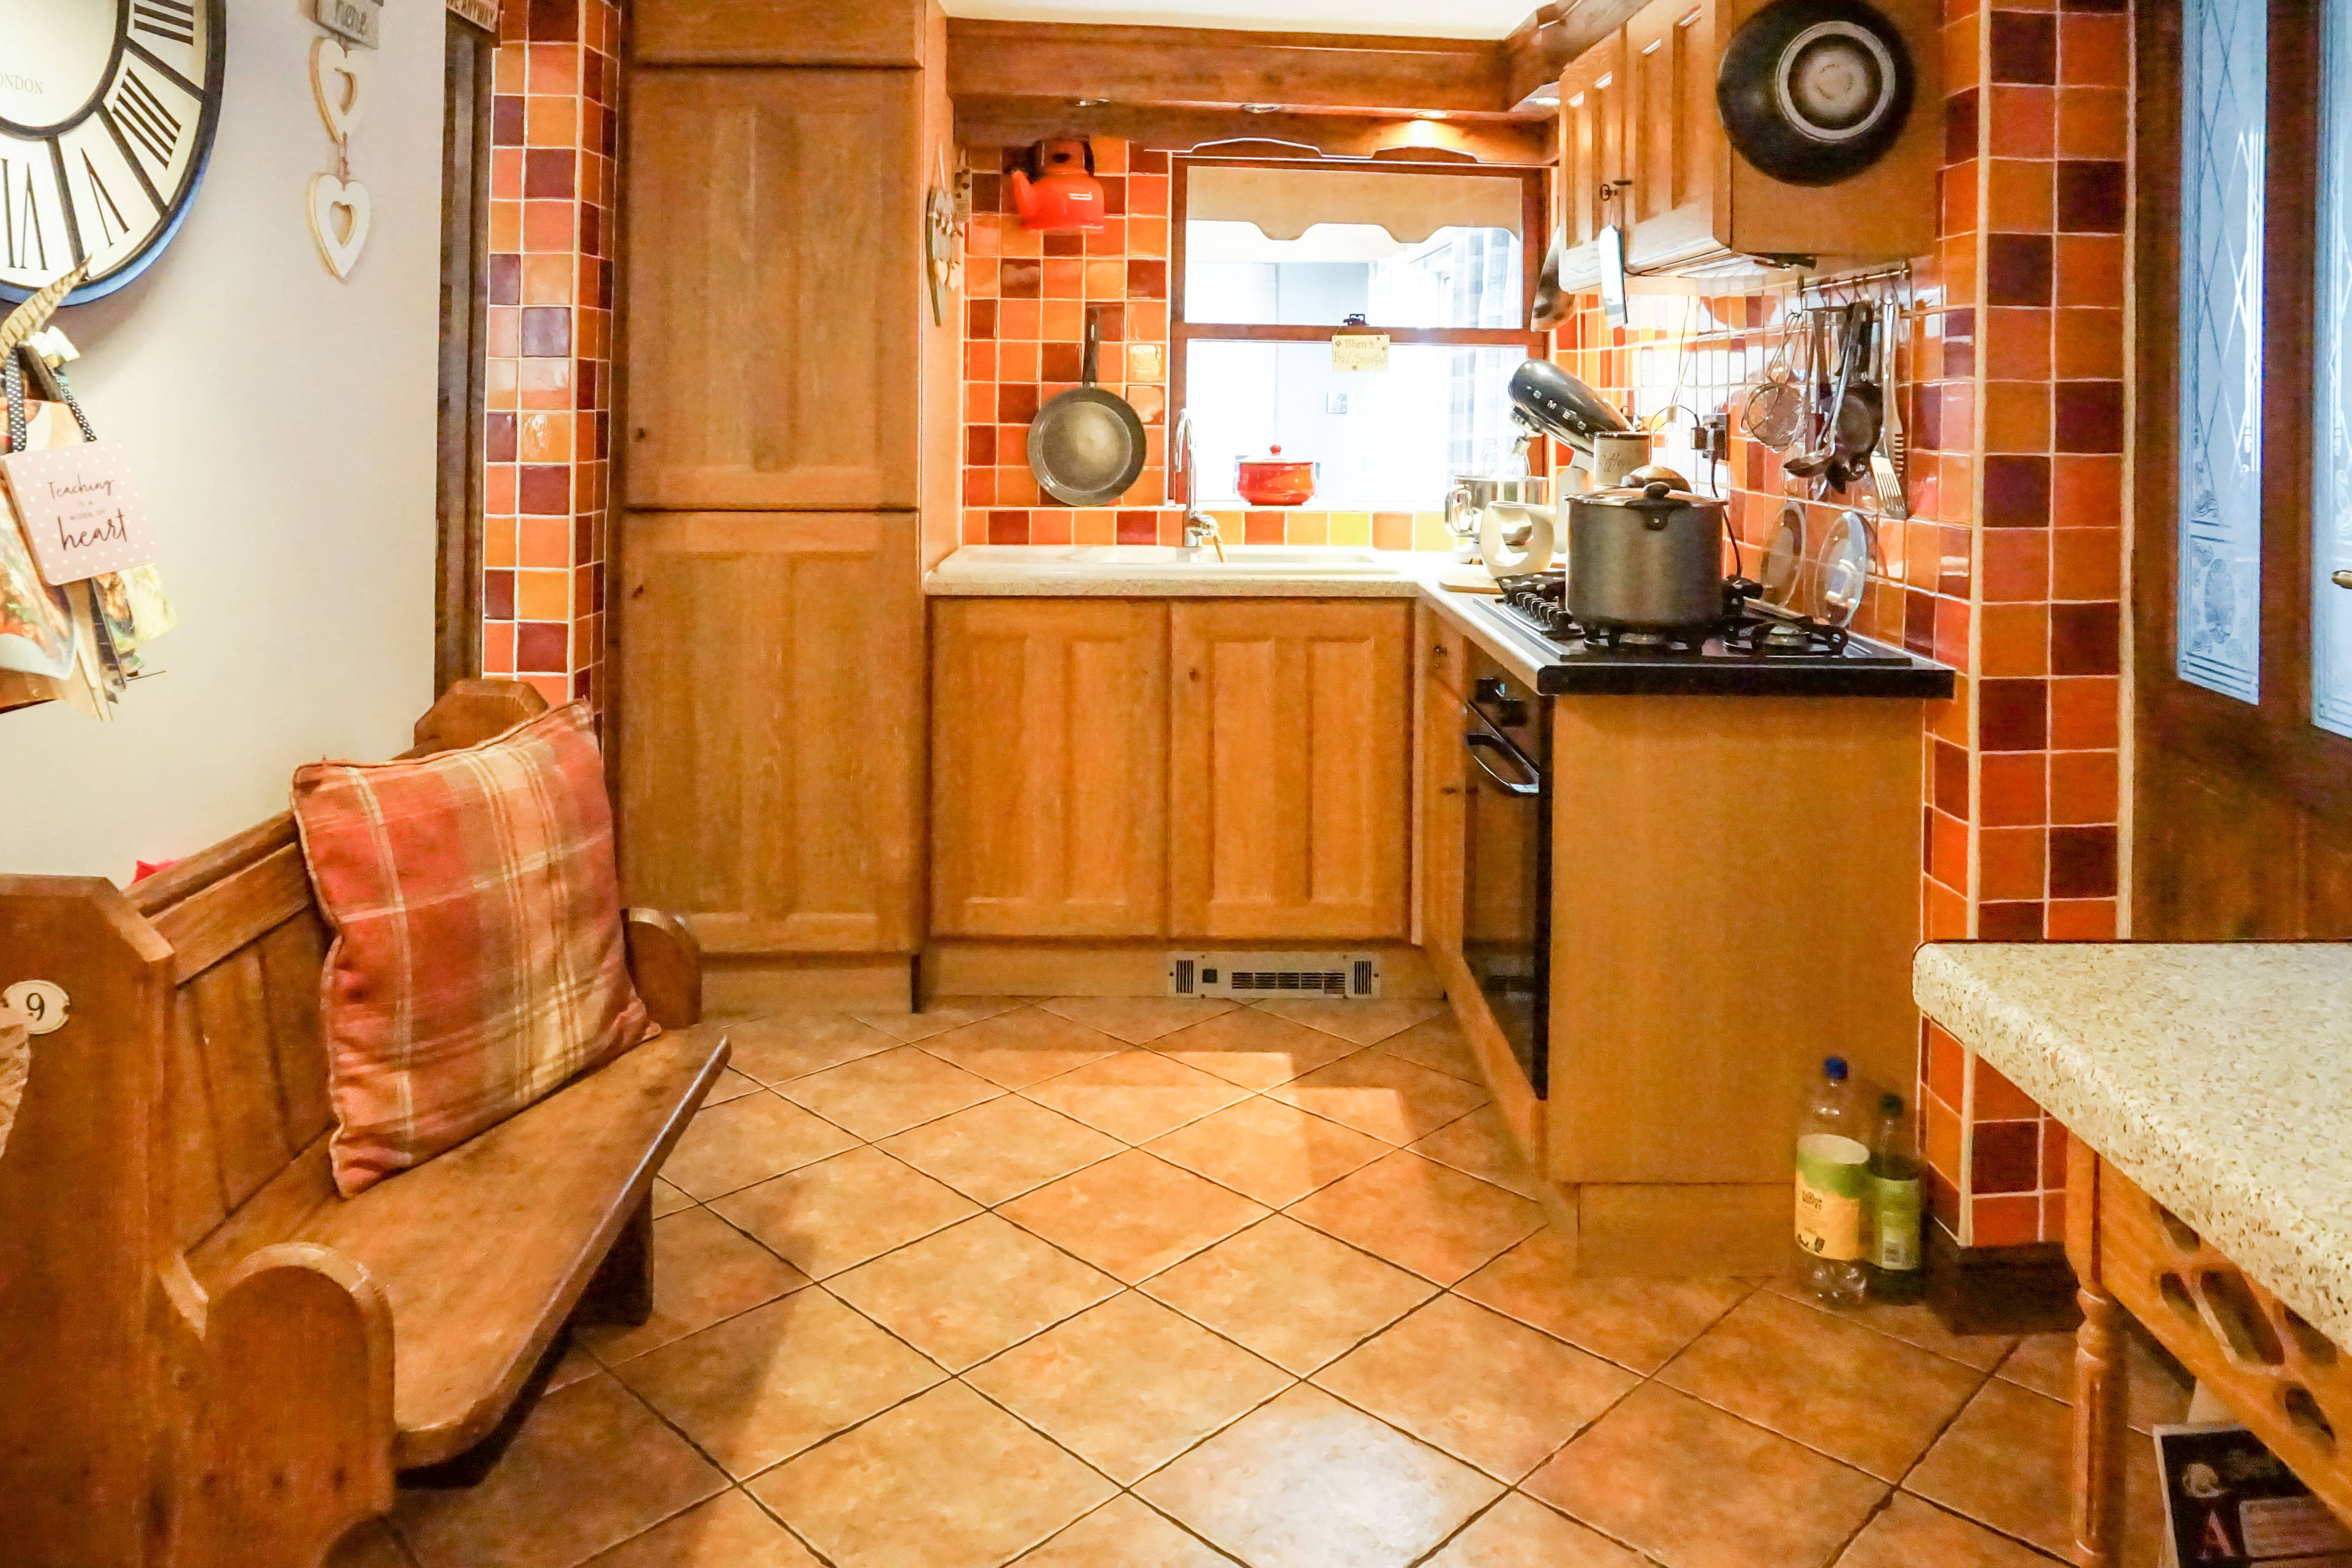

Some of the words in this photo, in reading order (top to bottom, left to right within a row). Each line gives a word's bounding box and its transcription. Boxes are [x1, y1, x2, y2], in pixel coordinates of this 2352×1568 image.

[1533, 390, 1586, 430] SMEG
[48, 474, 115, 500] Teaching
[58, 508, 127, 551] heart
[26, 992, 45, 1021] 9
